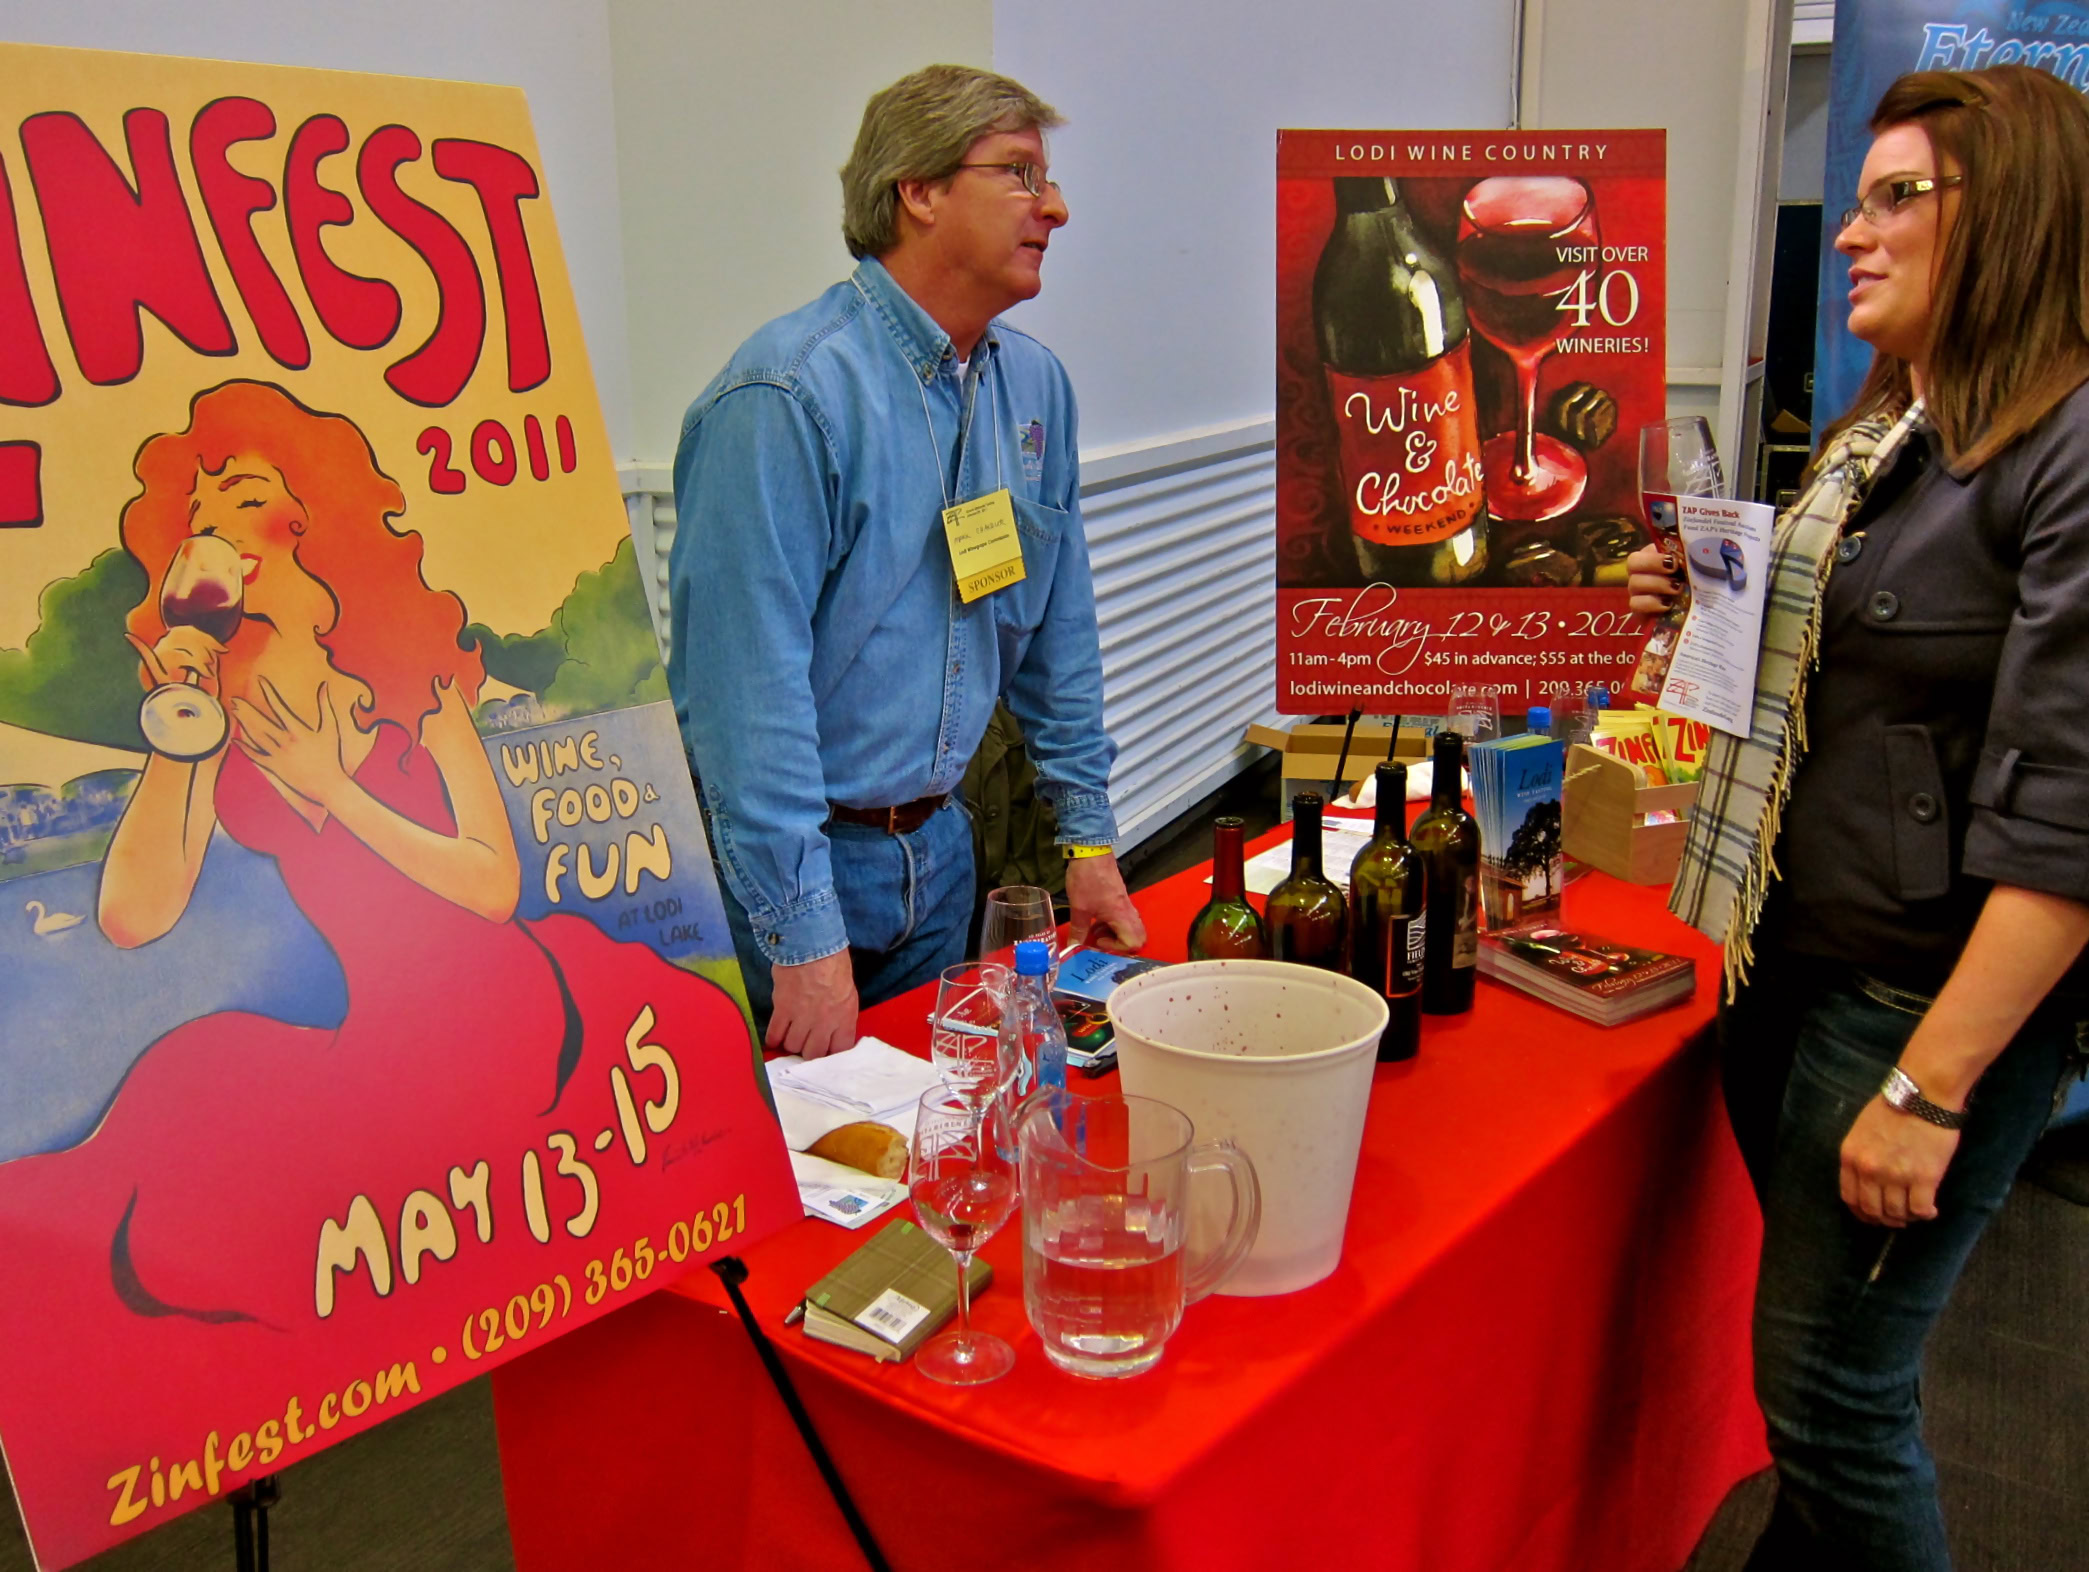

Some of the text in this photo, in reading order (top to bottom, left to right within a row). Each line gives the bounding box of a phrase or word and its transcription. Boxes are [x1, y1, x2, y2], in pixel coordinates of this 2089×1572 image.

[2006, 11, 2049, 32] New
[1335, 144, 1609, 161] LODI WINE COUNTRY
[0, 96, 551, 408] NFEST
[1555, 247, 1648, 263] VISIT OVER
[1555, 268, 1640, 327] 40
[1556, 337, 1649, 354] WINERIES!
[1344, 386, 1461, 435] Wine
[416, 414, 577, 495] 2011
[1404, 431, 1438, 474] &
[1355, 450, 1484, 517] Chocolate
[1386, 509, 1467, 537] WEEKEND
[1700, 507, 1720, 517] Gives
[1722, 509, 1740, 518] Back
[968, 565, 1016, 594] SPONSOR
[1291, 581, 1432, 675] February
[1447, 611, 1483, 636] 12
[1511, 611, 1550, 640] 13
[1424, 651, 1450, 666] $45
[1454, 652, 1468, 665] in
[1471, 652, 1537, 667] advance;
[1539, 651, 1566, 666] $55
[1569, 653, 1585, 665] at
[1588, 651, 1613, 665] the
[1616, 651, 1636, 666] do
[501, 730, 622, 787] WINE,
[1518, 762, 1553, 790] Lodi
[531, 777, 639, 844] FOOD
[544, 822, 673, 904] FUN
[618, 897, 682, 930] AT LODI
[659, 922, 703, 946] LAKE
[1071, 957, 1108, 982] Lodi
[314, 1002, 681, 1319] MAY 13-15
[106, 1193, 747, 1526] Zinfest.com (209) 365-0621
